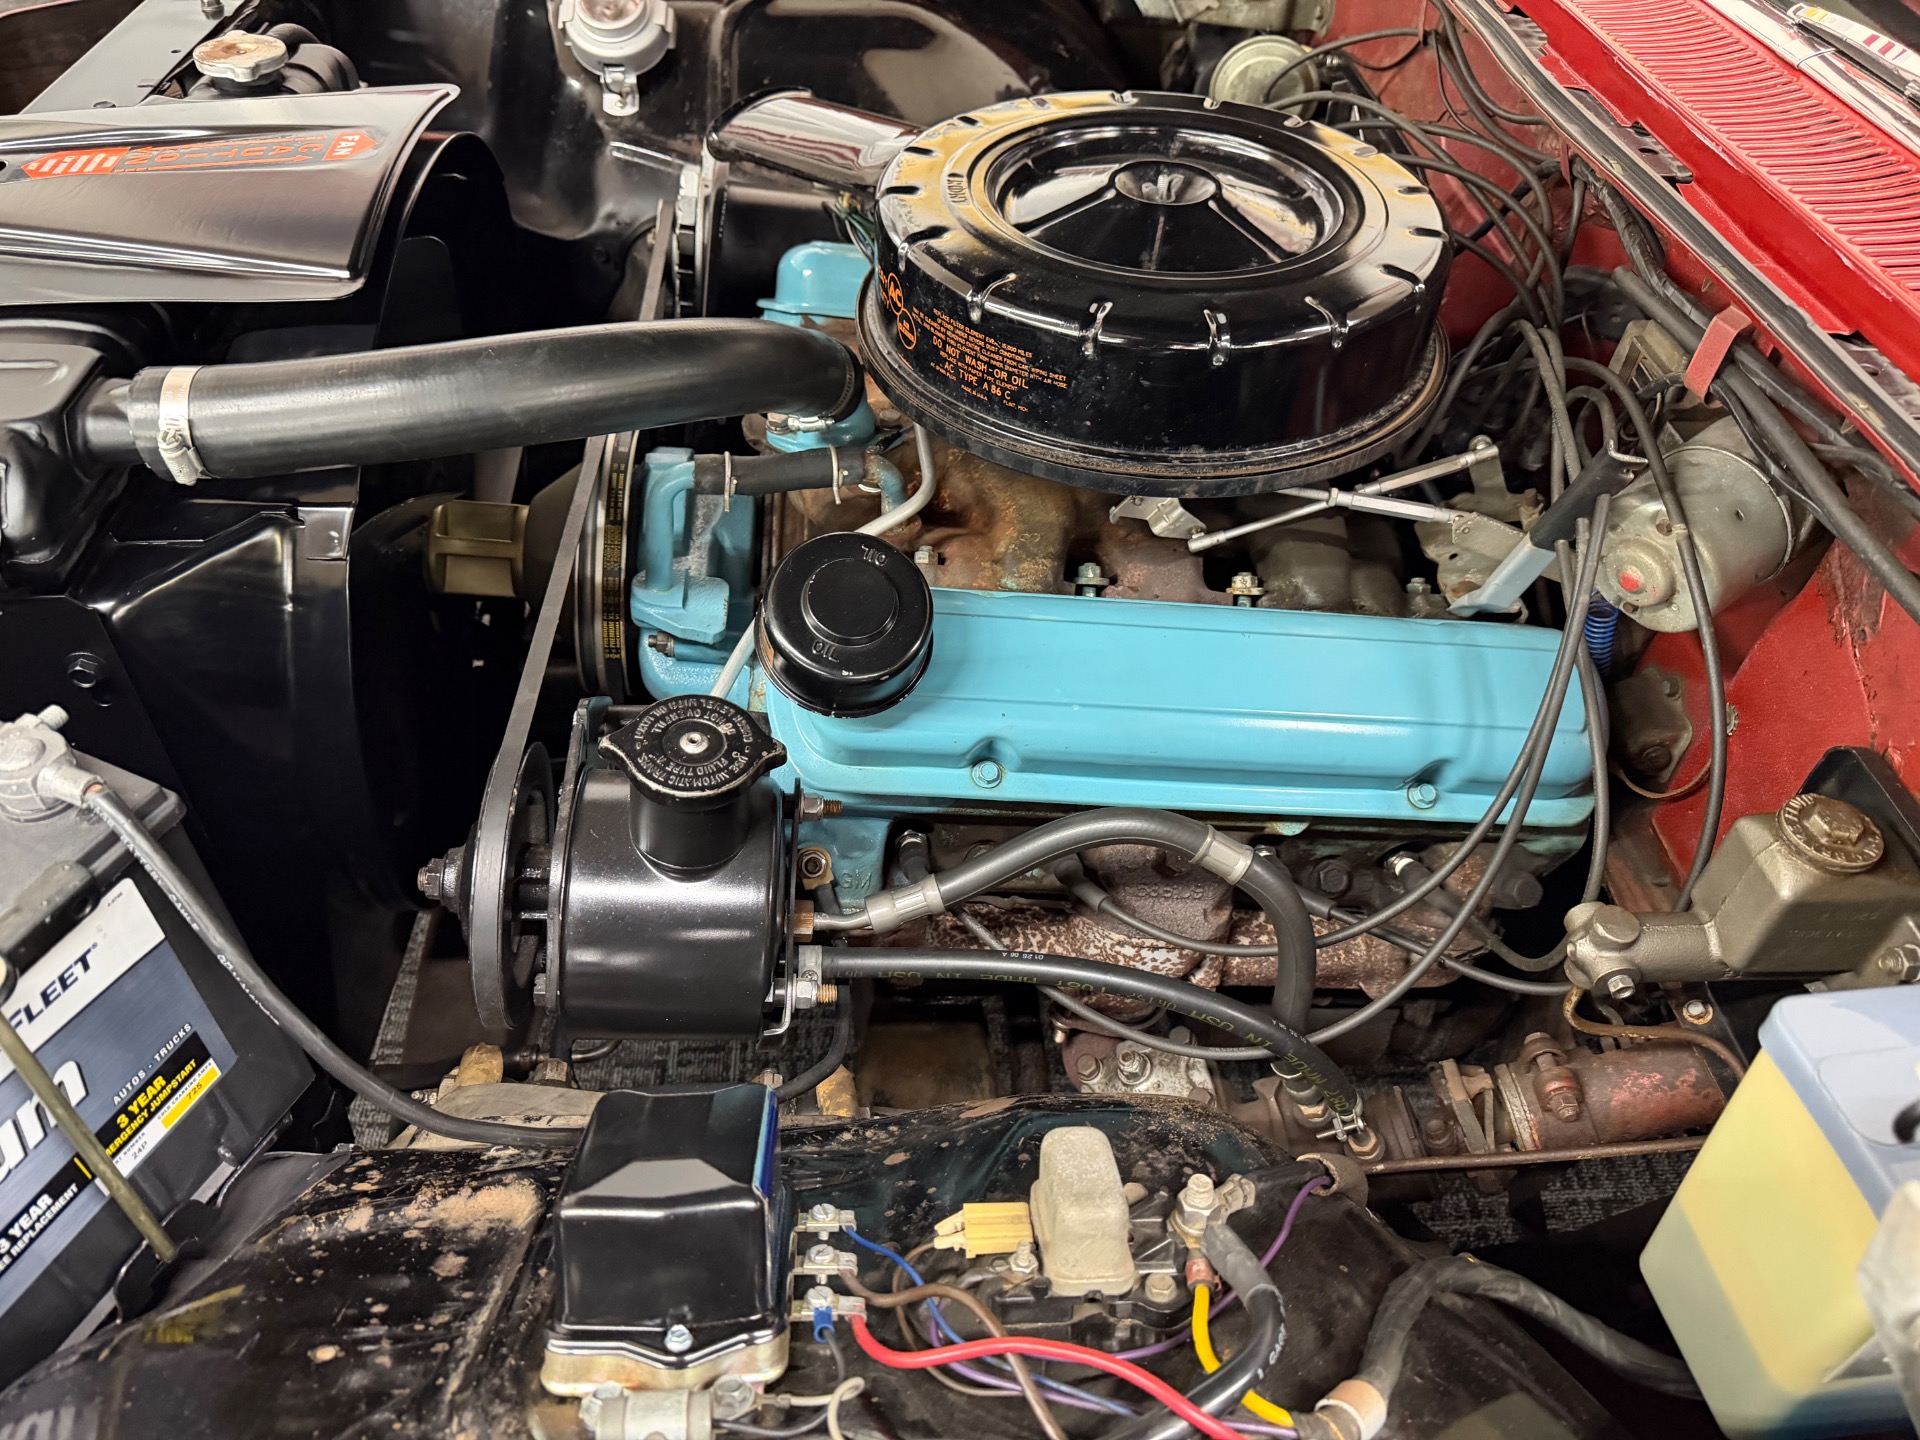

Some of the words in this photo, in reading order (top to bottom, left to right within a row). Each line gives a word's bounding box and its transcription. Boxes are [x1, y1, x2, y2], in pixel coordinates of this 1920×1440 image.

[125, 143, 324, 165] CAUTION
[332, 134, 361, 156] FAN
[888, 280, 902, 307] AC
[932, 336, 943, 348] DO
[945, 344, 959, 358] NOT
[1010, 375, 1030, 389] OIL
[944, 361, 955, 372] AC
[957, 369, 979, 385] TYPE
[982, 381, 990, 390] A
[989, 384, 1003, 396] 86
[1003, 390, 1012, 399] C
[811, 639, 840, 663] OIL
[667, 698, 697, 709] WITH
[650, 708, 701, 732] OVERFILL
[665, 761, 694, 775] TYPE
[696, 757, 728, 775] FLUID
[728, 754, 748, 773] USE
[667, 769, 729, 787] AUTOMATIC
[840, 869, 872, 889] GM
[1190, 1010, 1235, 1032] USA
[1245, 1032, 1273, 1047] IN
[113, 1069, 146, 1105] AUTOS
[153, 1022, 192, 1062] TRUCKS
[197, 1061, 212, 1078] AMPS
[1284, 1051, 1327, 1084] MADE
[116, 1113, 130, 1129] 3
[127, 1075, 167, 1115] YEAR
[186, 1083, 203, 1100] 725
[105, 1108, 149, 1156] MERGENCY
[150, 1058, 197, 1112] JUMPSTART
[131, 1140, 148, 1160] 24P
[8, 1192, 54, 1240] YEAR
[10, 1182, 80, 1257] REPLACEMENT
